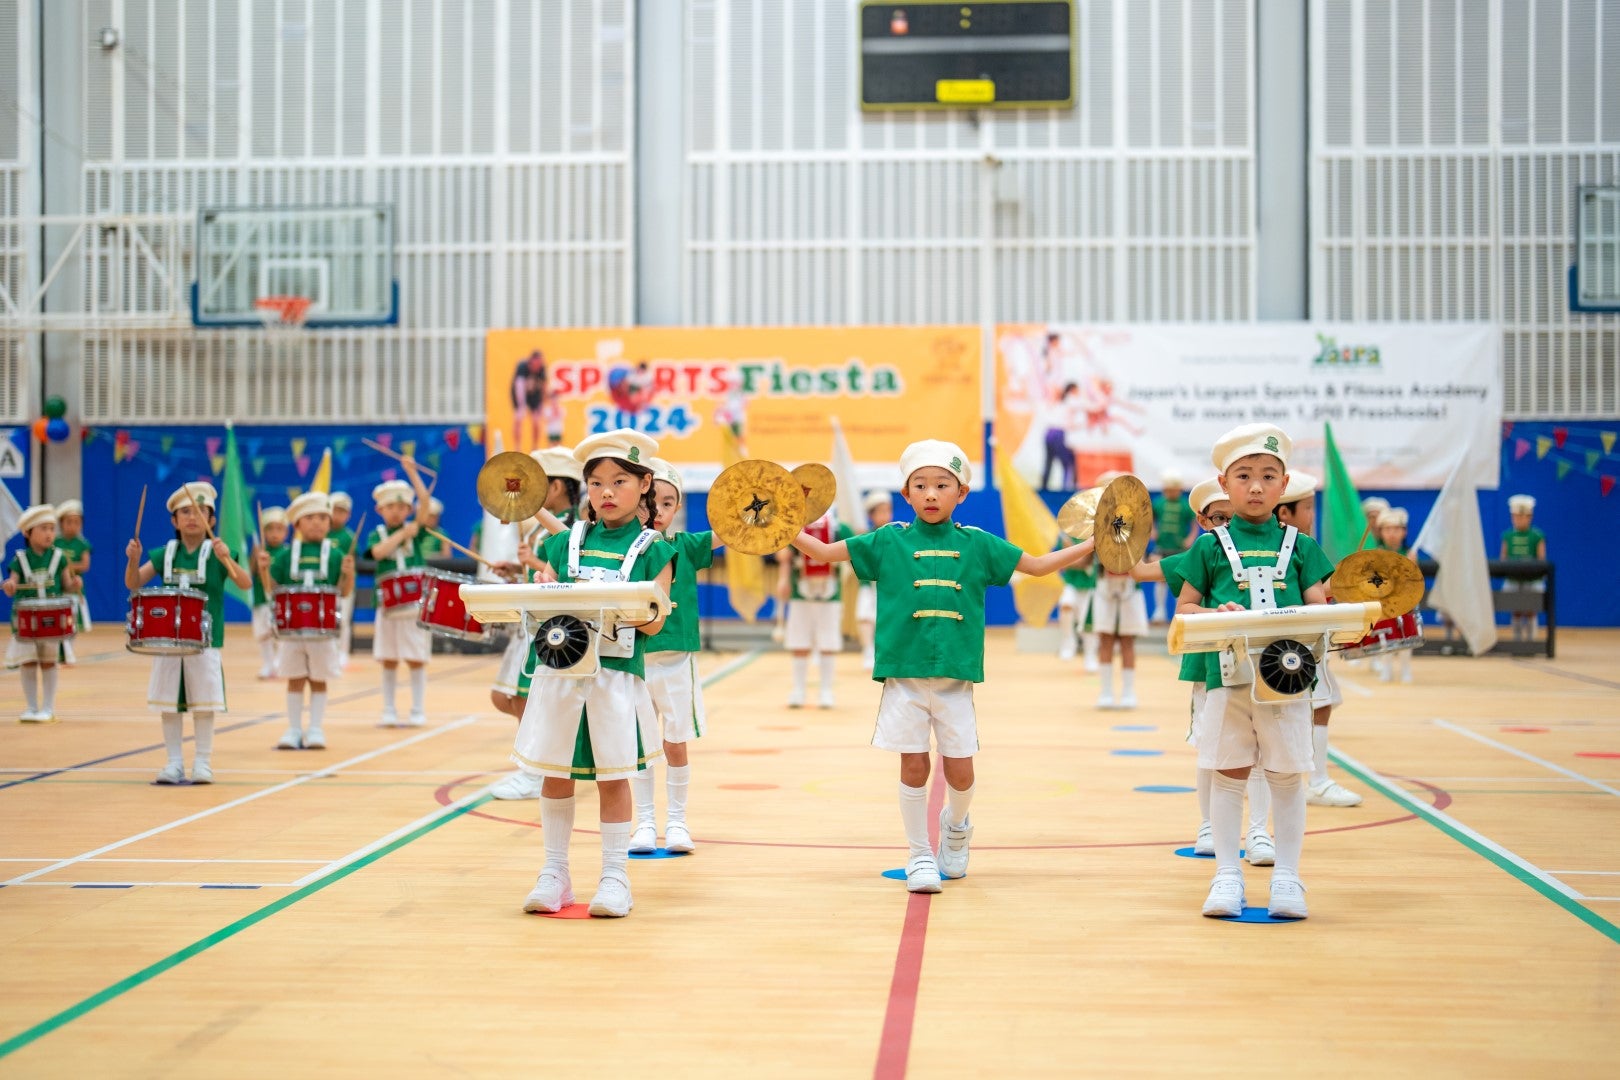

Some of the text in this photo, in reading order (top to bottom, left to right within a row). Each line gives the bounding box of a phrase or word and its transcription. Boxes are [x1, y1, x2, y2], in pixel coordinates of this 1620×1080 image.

[739, 363, 898, 393] Fiesta
[1193, 385, 1257, 402] Largest
[1263, 384, 1318, 400] Sports
[1325, 385, 1336, 398] &
[1343, 385, 1402, 398] Fitness
[1410, 383, 1488, 401] Academy
[591, 408, 694, 433] 2024
[1203, 407, 1246, 419] more
[0, 449, 16, 469] A
